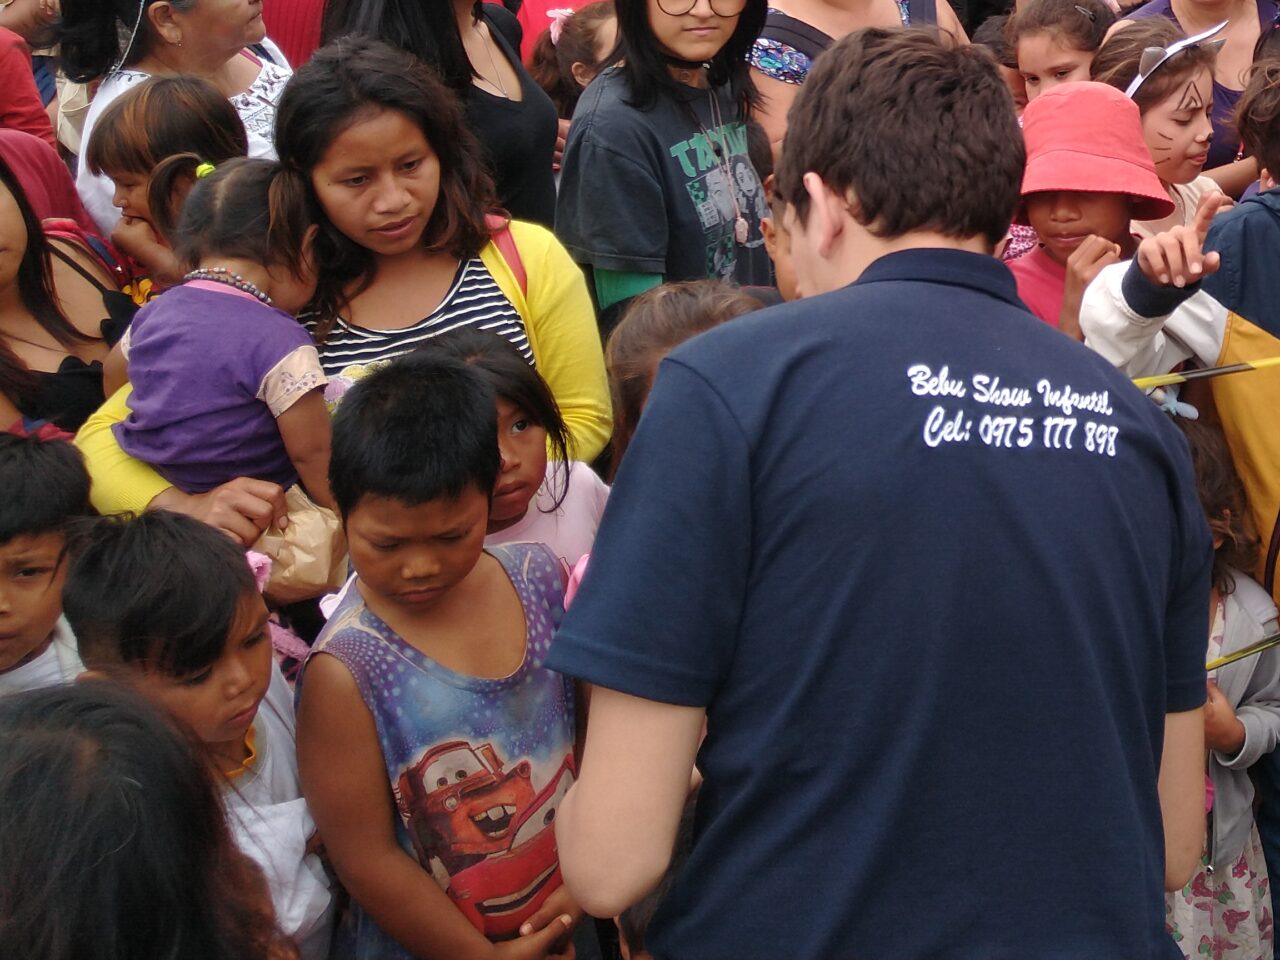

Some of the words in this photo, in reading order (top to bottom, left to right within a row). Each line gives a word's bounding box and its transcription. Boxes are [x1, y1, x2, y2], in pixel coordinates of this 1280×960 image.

[972, 373, 1032, 407] Show
[923, 405, 973, 448] Cel:
[978, 414, 1034, 448] 0975
[1043, 416, 1078, 450] 177
[1084, 421, 1120, 457] 898
